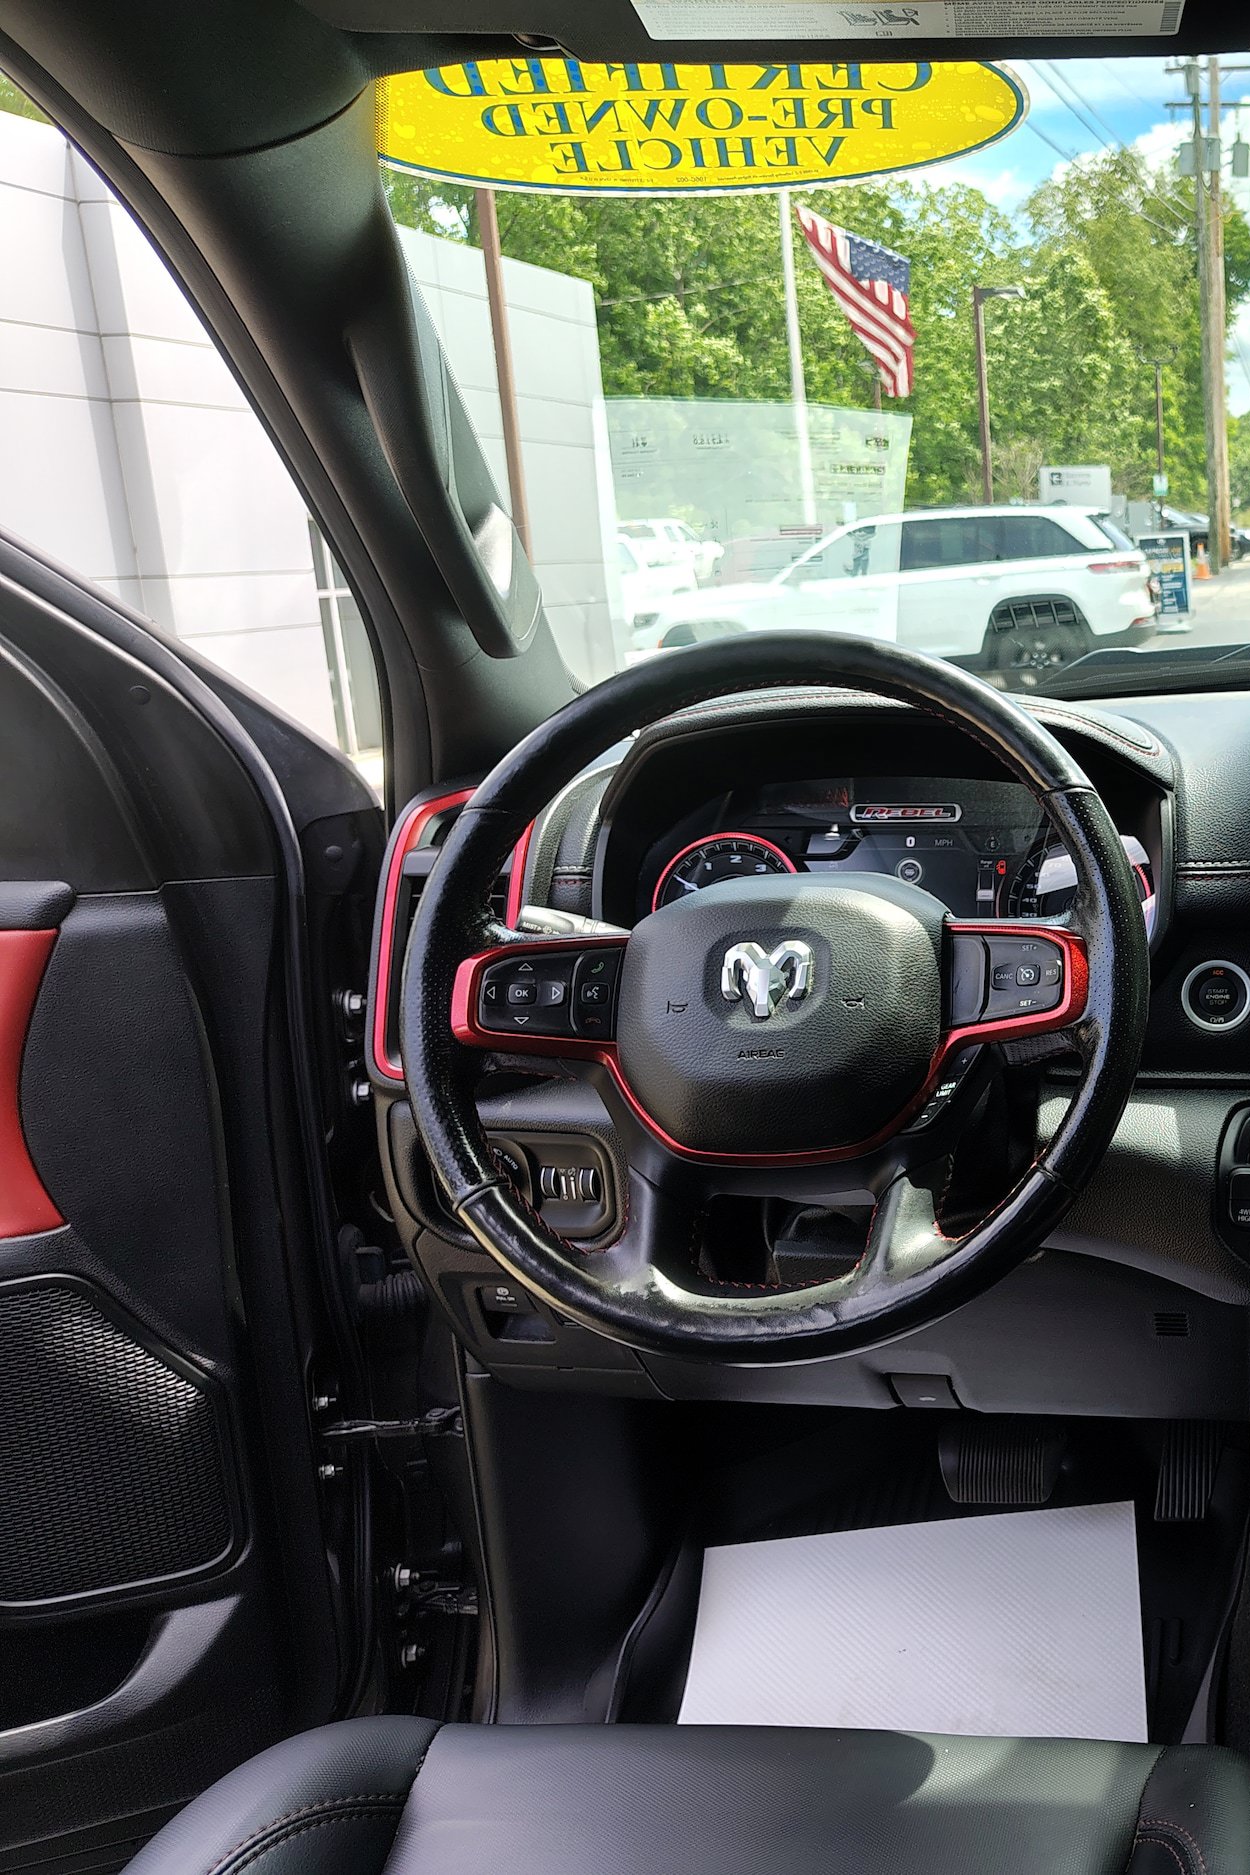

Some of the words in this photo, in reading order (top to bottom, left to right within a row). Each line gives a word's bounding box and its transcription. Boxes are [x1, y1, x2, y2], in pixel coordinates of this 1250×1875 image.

[856, 806, 952, 819] REBEL
[905, 836, 916, 848] 0
[934, 839, 953, 847] MPH
[730, 855, 743, 863] 2
[704, 862, 713, 870] 1
[755, 864, 767, 872] 3
[522, 921, 538, 931] MIST
[1045, 968, 1057, 976] RES
[514, 989, 529, 997] OK
[940, 1082, 957, 1090] GEAR
[503, 1154, 519, 1170] AUTO
